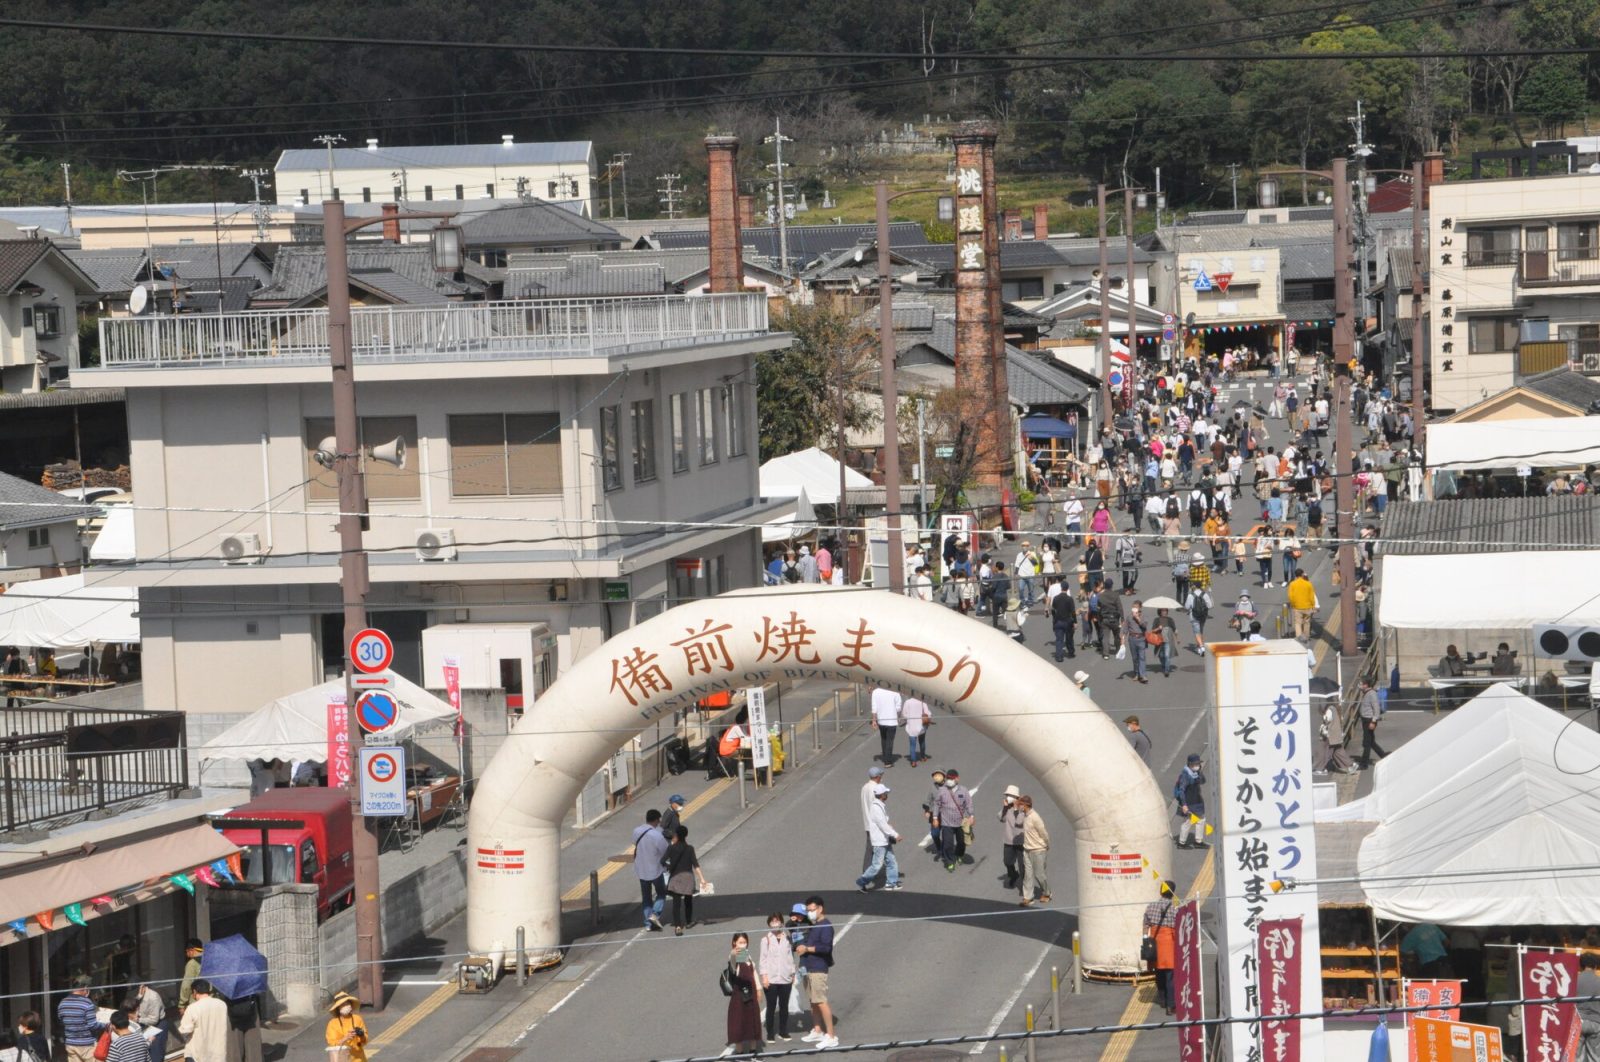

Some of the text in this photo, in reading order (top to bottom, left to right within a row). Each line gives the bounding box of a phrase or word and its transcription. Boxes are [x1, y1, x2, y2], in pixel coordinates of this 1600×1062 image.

[359, 641, 384, 662] 30
[610, 611, 981, 707] 備前焼まつり
[641, 678, 730, 720] FESTIVAL
[744, 670, 772, 682] OF
[784, 669, 850, 681] BIZEN
[366, 802, 402, 811] この先200m
[1178, 911, 1194, 1062] 備前焼まつ
[1489, 1032, 1500, 1062] 備前
